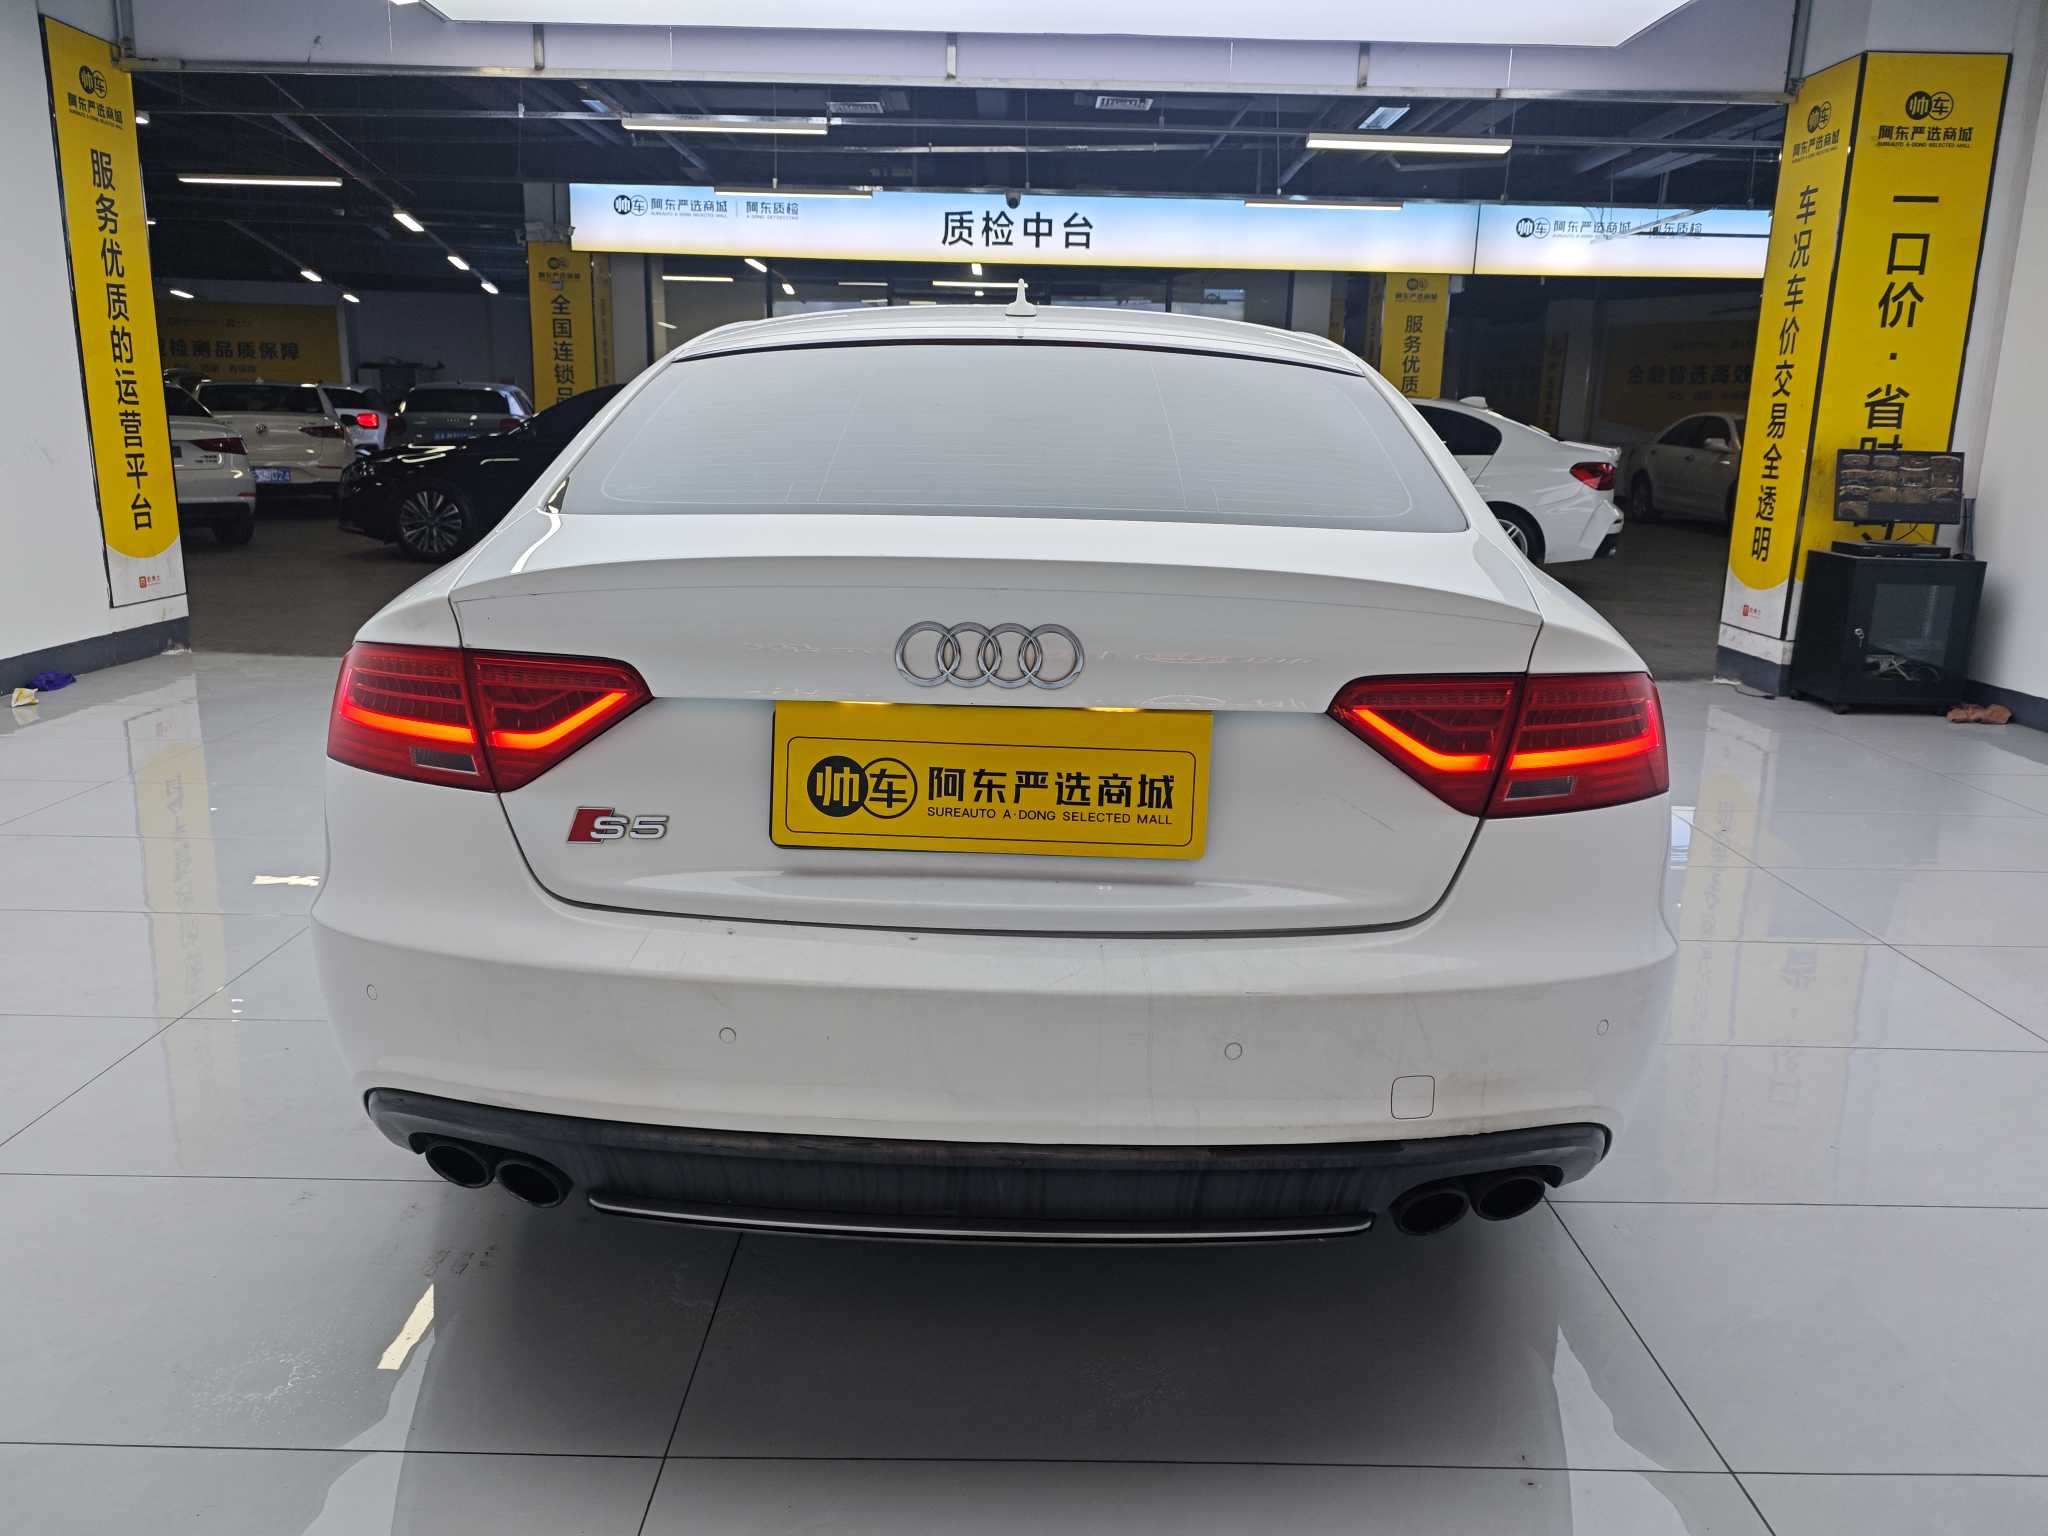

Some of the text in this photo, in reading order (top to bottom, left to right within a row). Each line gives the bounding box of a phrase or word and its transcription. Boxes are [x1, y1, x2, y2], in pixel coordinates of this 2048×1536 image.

[1878, 125, 1975, 141] 阿东严选商城
[651, 198, 728, 213] 阿东严选商城
[746, 201, 800, 216] 阿东质检
[941, 210, 1094, 249] 质检中台
[90, 148, 153, 531] 服务优质的运营平台
[1401, 315, 1424, 394] 服务优质
[1751, 184, 1819, 563] 车况车价交易全透明
[810, 760, 1175, 814] 帅车 阿东严选商城
[589, 814, 670, 840] S5
[927, 806, 996, 819] SUREAUTO
[1062, 811, 1131, 824] SELECTED
[1136, 813, 1173, 825] MALL
